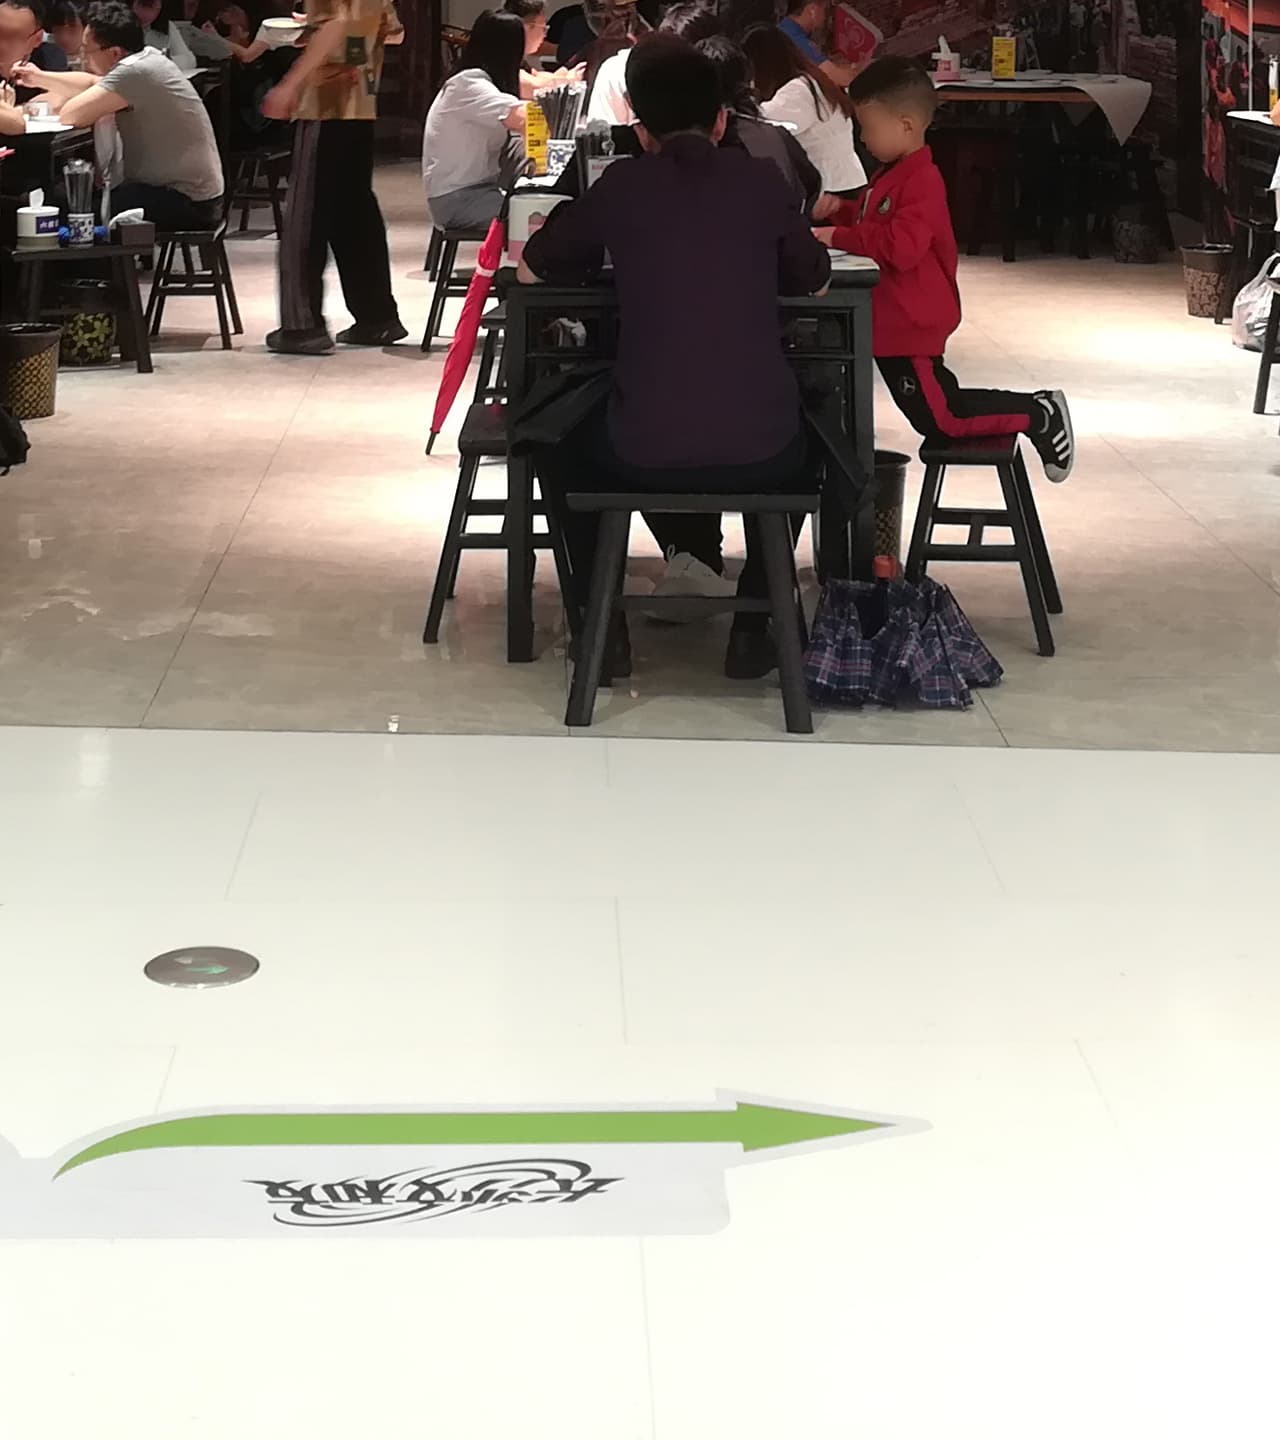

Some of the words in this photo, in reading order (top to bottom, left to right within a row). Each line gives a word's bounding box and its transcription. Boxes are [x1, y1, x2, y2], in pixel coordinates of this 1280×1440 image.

[242, 1166, 624, 1211] 长沙文和友
